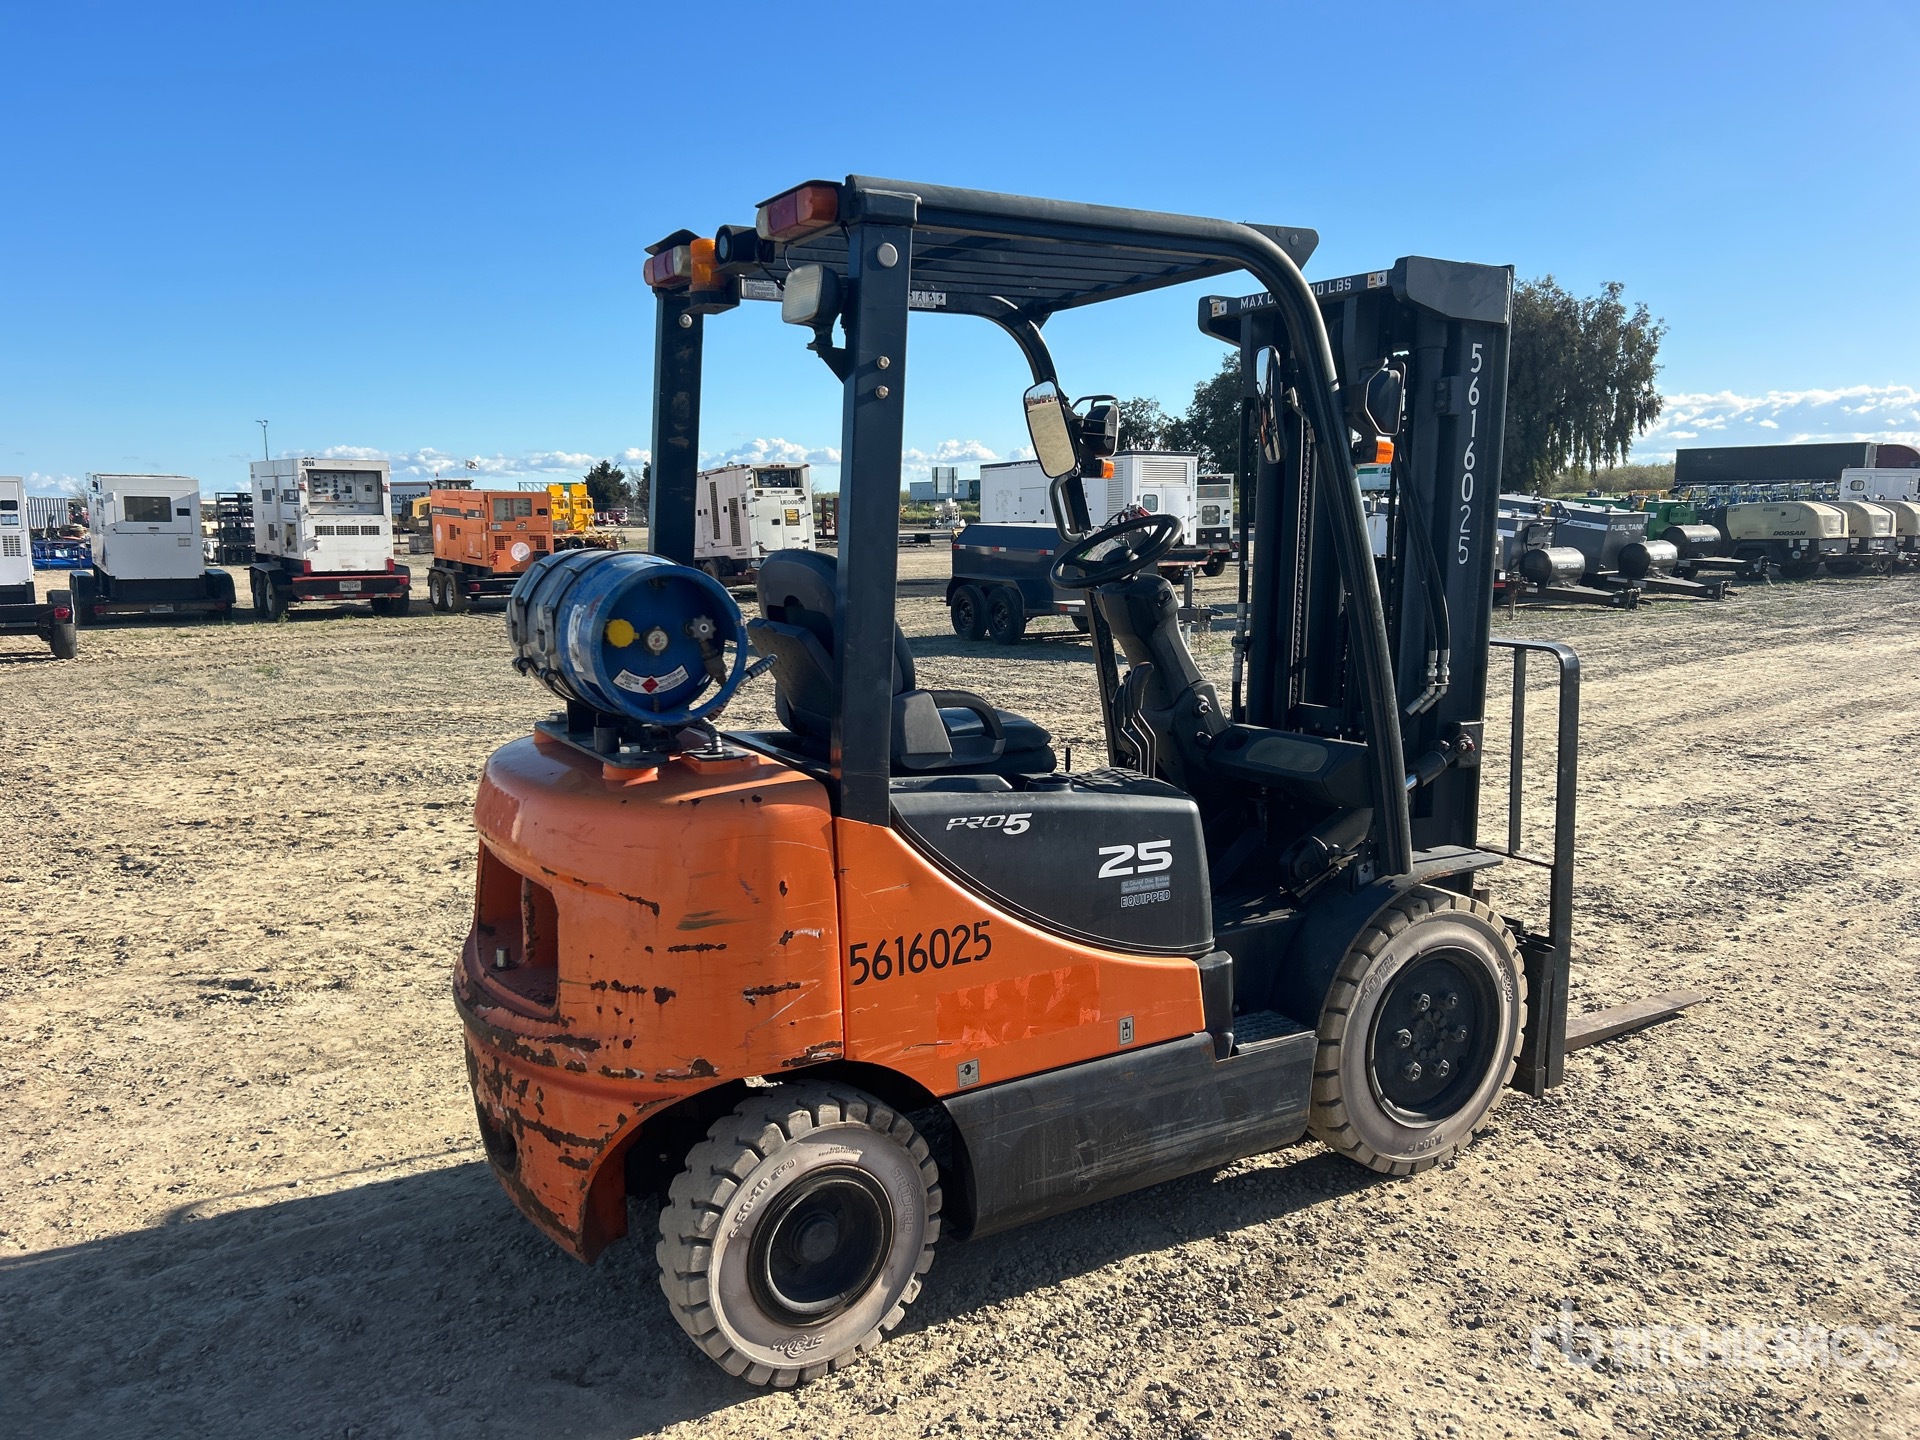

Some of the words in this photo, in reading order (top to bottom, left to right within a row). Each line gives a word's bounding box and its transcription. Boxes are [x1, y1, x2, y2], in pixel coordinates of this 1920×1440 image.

[1240, 293, 1264, 310] MAX
[1328, 277, 1352, 294] LBS
[1457, 342, 1483, 565] 5616025
[1610, 524, 1627, 532] FUEL
[1628, 523, 1645, 531] TANK
[1097, 839, 1173, 879] 25
[1121, 890, 1170, 907] EQUIPPED
[850, 920, 993, 987] 5616025
